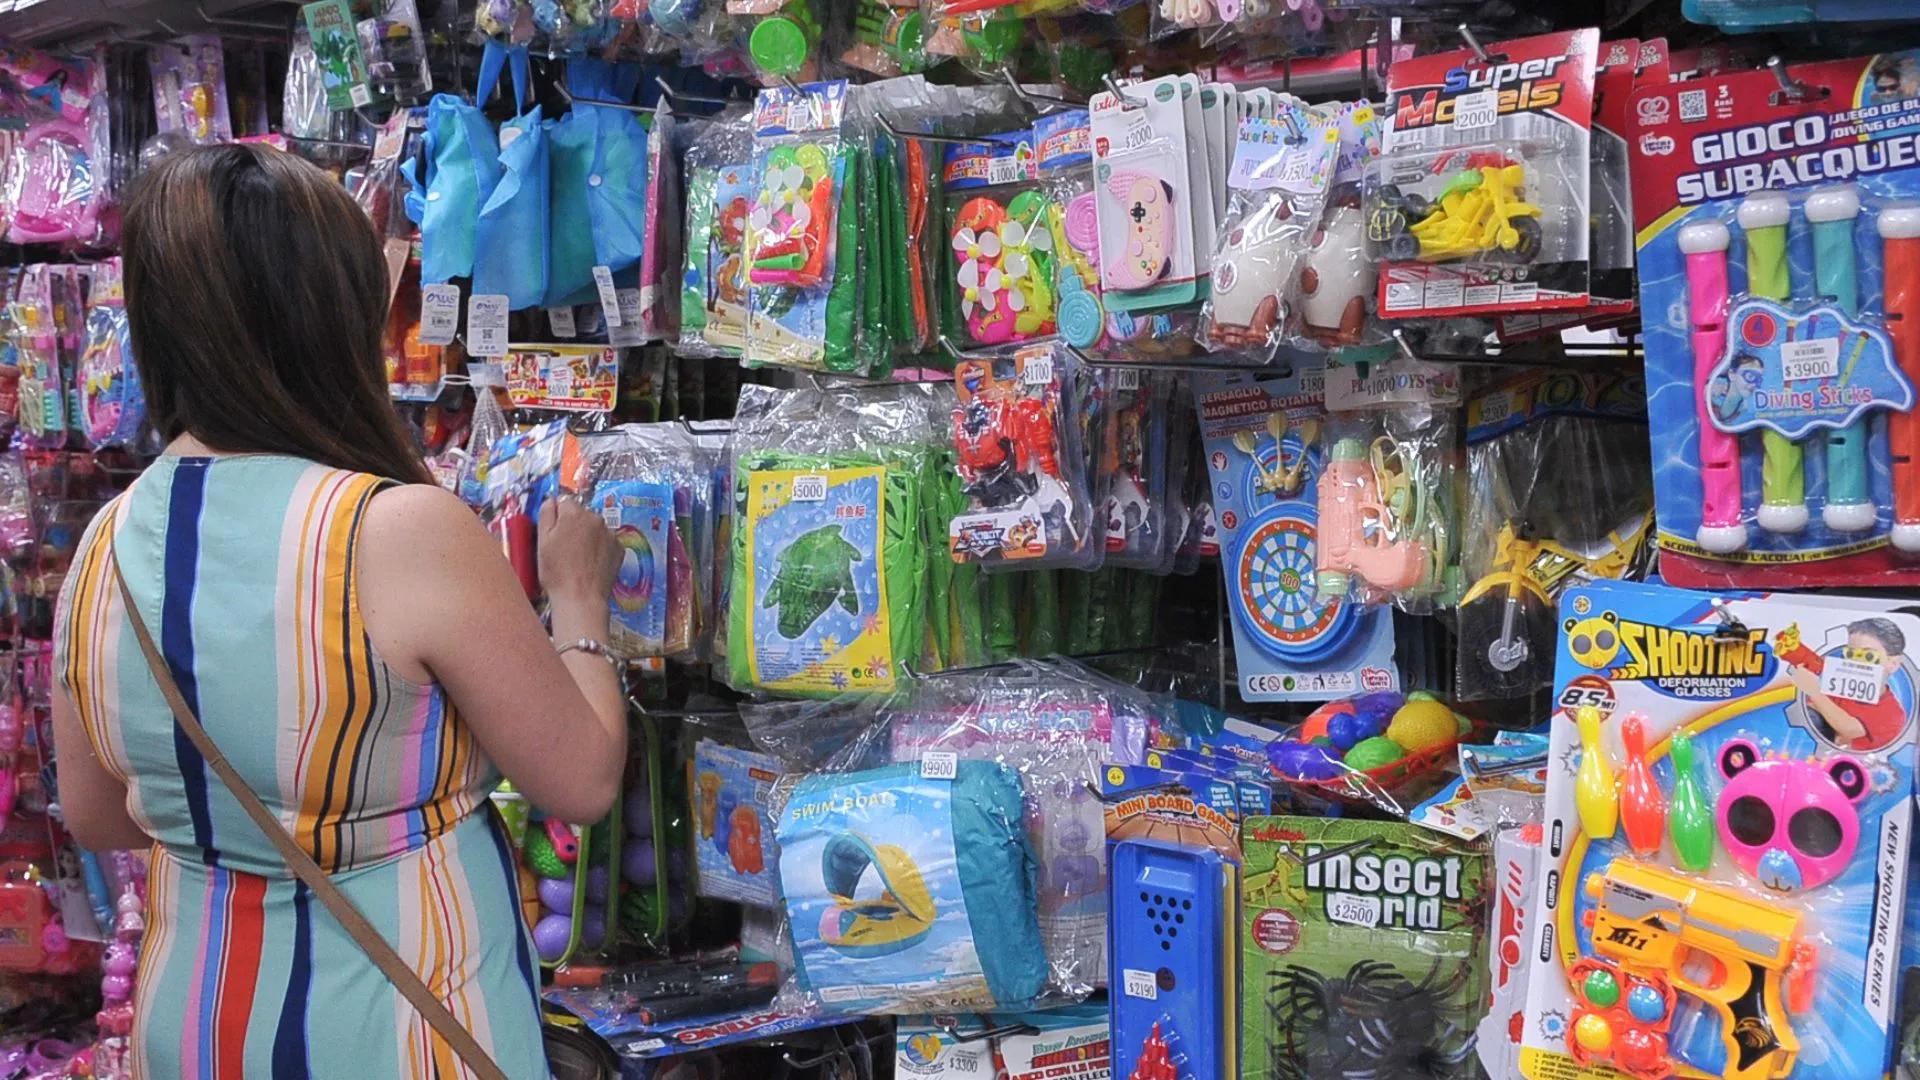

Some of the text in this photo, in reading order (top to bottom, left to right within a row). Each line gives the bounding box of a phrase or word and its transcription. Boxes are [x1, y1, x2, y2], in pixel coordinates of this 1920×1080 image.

[1443, 53, 1571, 93] Super
[1718, 85, 1728, 98] 3
[1394, 81, 1565, 131] Moels
[1881, 101, 1901, 114] DE
[1126, 125, 1152, 148] $2000
[1692, 115, 1826, 165] GIOCO
[990, 167, 1016, 182] $1000
[1025, 364, 1049, 380] $1700
[1785, 361, 1831, 378] $3900
[1271, 392, 1325, 409] ROTANTE
[1755, 384, 1873, 412] Diving Sticks
[1619, 618, 1768, 679] SHOOTING
[1658, 676, 1746, 689] DEFORMATION
[1674, 686, 1732, 698] GLASSES
[1829, 676, 1876, 701] $1990
[922, 761, 953, 776] $9900
[791, 793, 892, 821] SWIM BOAT
[1115, 796, 1145, 819] MINI
[1147, 795, 1195, 815] BOARD
[1197, 804, 1234, 836] GAME
[1306, 845, 1462, 899] Insect
[1335, 903, 1374, 924] $2500
[1869, 820, 1899, 1008] NEW SHOOTING SERIES
[1129, 982, 1155, 998] $2190
[949, 1056, 978, 1073] $3300
[1046, 1064, 1071, 1078] CON
